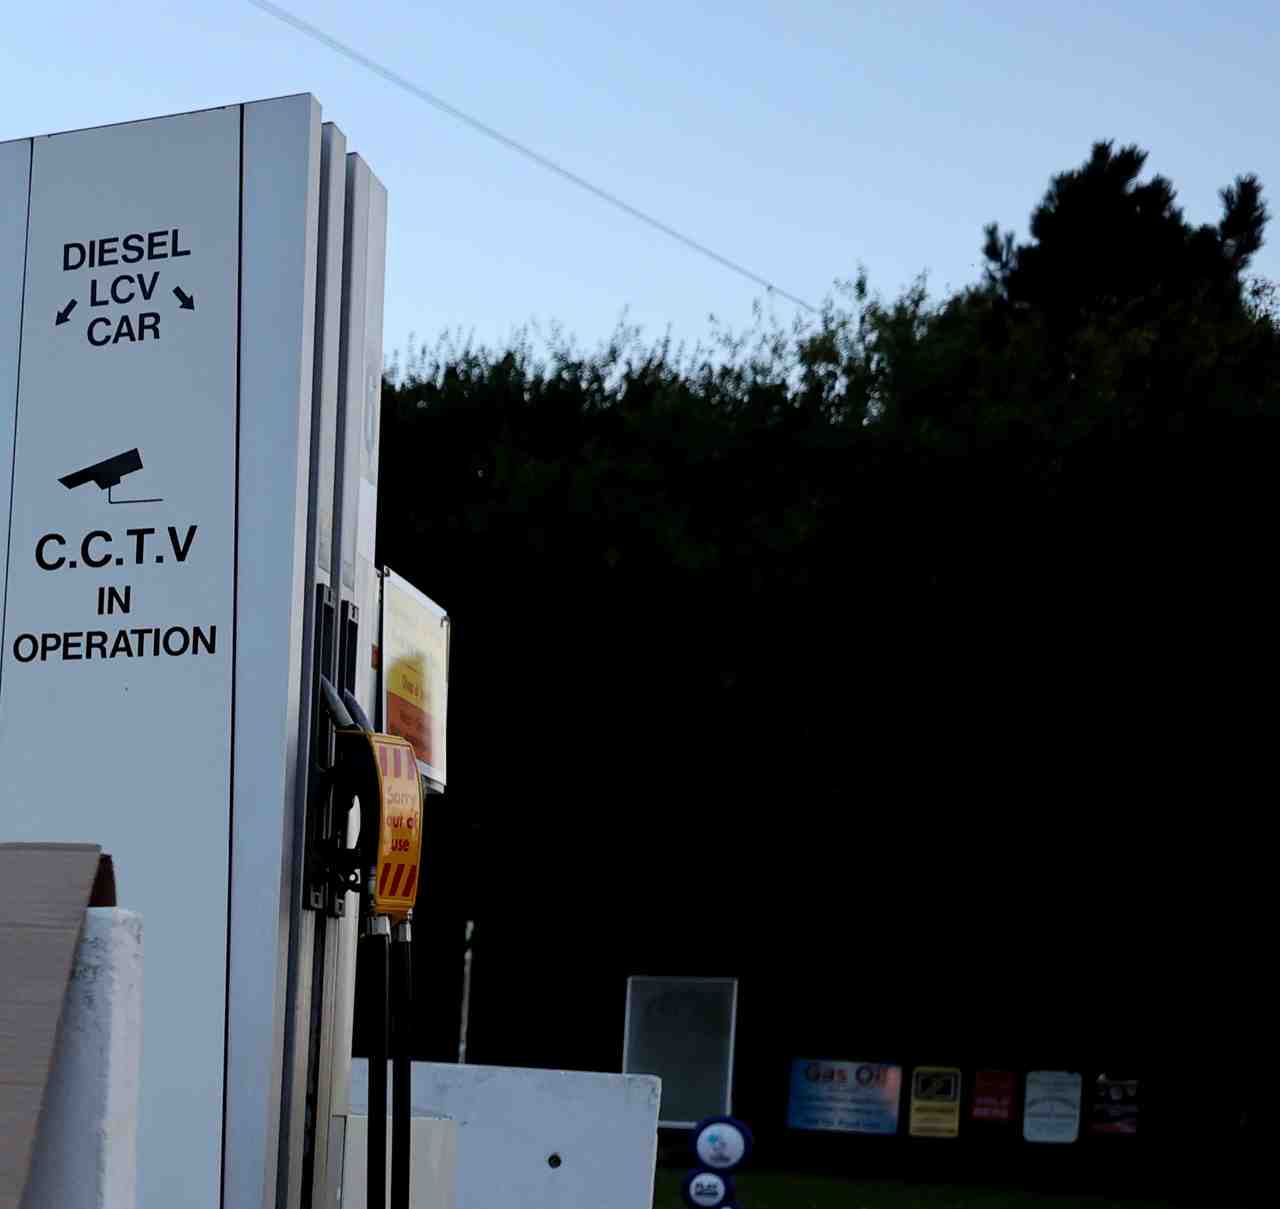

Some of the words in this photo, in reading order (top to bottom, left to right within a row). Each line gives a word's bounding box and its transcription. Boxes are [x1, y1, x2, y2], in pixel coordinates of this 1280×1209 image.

[63, 229, 191, 271] DIESEL
[89, 271, 160, 307] LCV
[86, 312, 161, 346] CAR
[35, 525, 198, 570] C.C.T.V
[97, 586, 131, 615] IN
[13, 625, 217, 663] OPERATION
[391, 838, 410, 853] use
